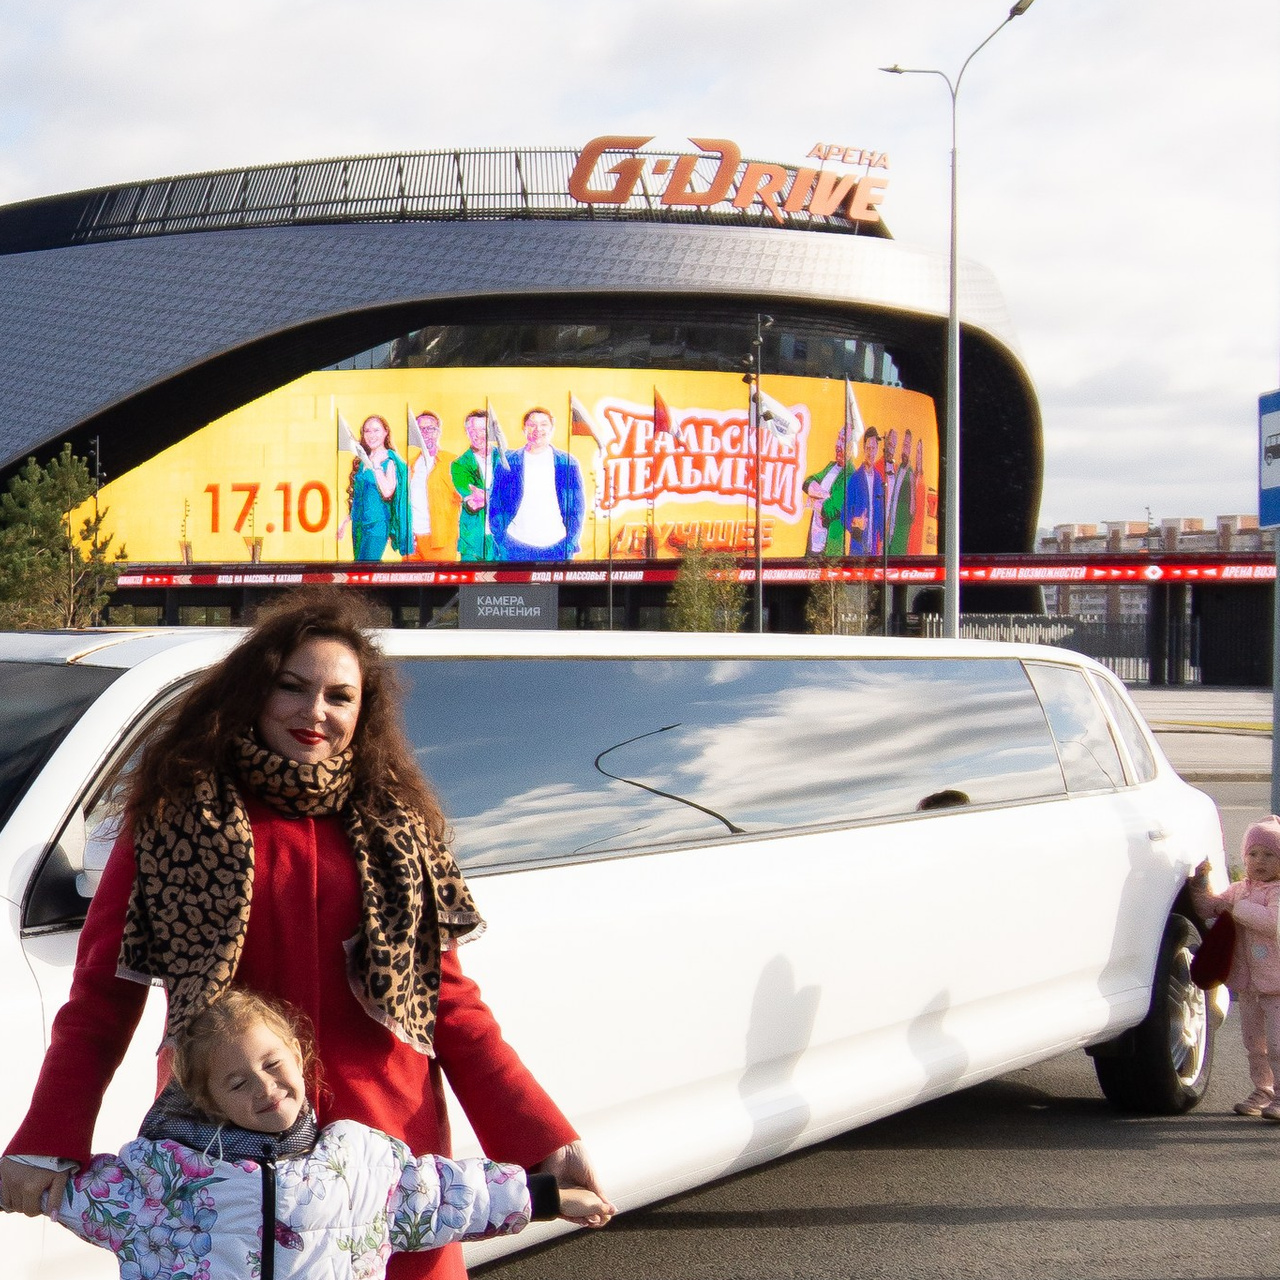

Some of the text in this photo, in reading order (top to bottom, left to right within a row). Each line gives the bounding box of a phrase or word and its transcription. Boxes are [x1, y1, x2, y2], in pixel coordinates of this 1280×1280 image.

[806, 142, 891, 170] АРЕНА
[203, 479, 332, 534] 17.10
[531, 571, 552, 581] ВХОД
[553, 571, 563, 580] НА
[565, 571, 607, 580] МАССОВЫЕ
[990, 567, 1017, 579] АРЕНА
[1221, 566, 1253, 578] АРЕНА
[477, 596, 525, 606] КАМЕРА
[477, 607, 541, 617] ХРАНЕНИЯ
